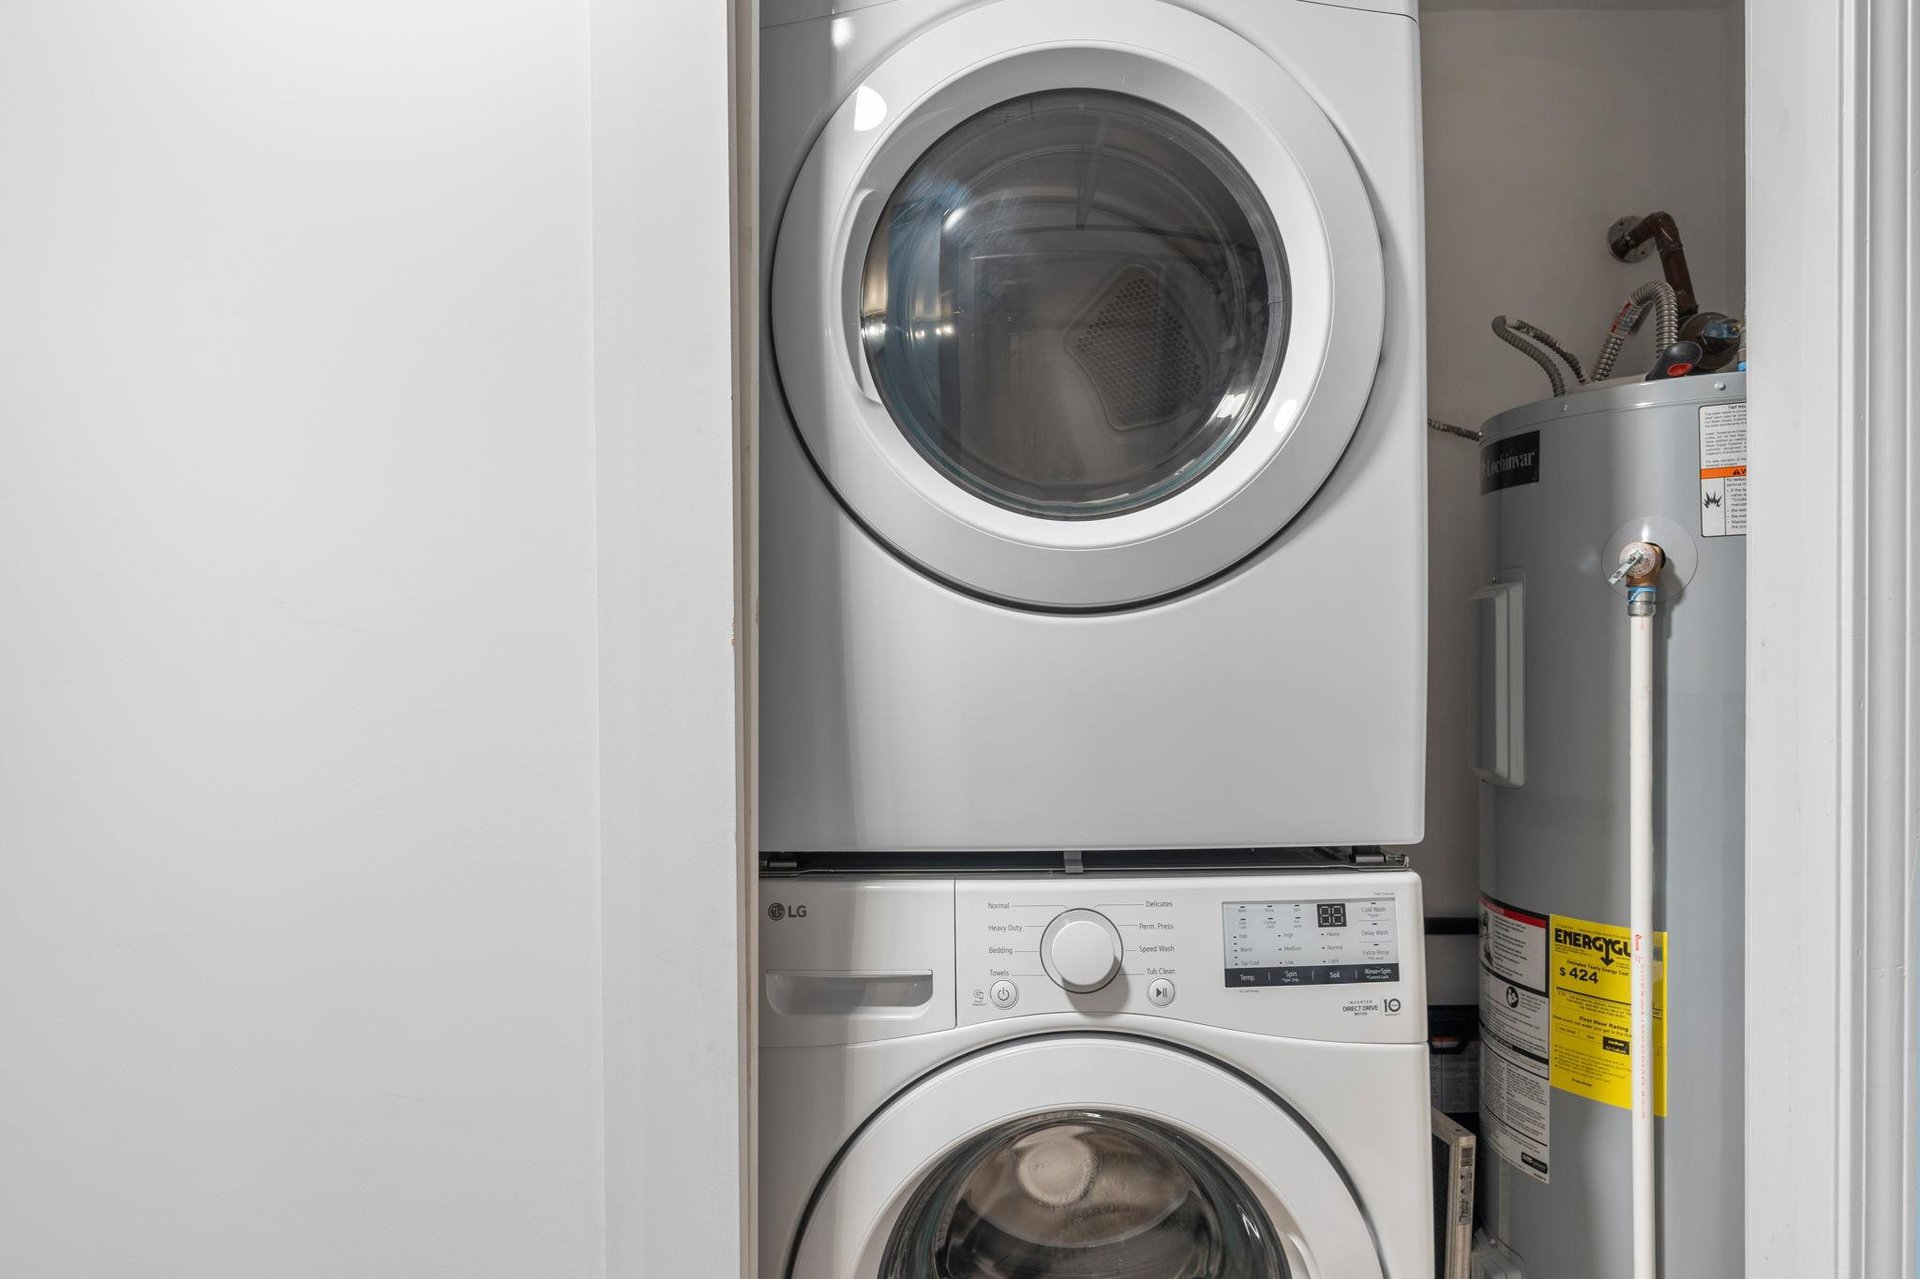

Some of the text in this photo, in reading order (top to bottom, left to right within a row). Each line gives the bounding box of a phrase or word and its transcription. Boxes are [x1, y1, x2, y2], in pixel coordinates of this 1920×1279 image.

[788, 905, 807, 918] LG
[988, 924, 1023, 932] Heavy Duty
[1139, 922, 1156, 930] Perm.
[988, 946, 1013, 955] Bedding
[1138, 945, 1157, 953] Speed
[989, 969, 1010, 977] Towels
[1284, 970, 1298, 978] Spin
[1329, 971, 1341, 979] Soil
[1364, 968, 1392, 976] Rinse+Spin
[1601, 967, 1618, 975] Energy
[1239, 974, 1255, 982] Temp.
[1569, 967, 1599, 984] 424
[1383, 998, 1401, 1013] 10
[1579, 1015, 1629, 1032] First Hour Rating
